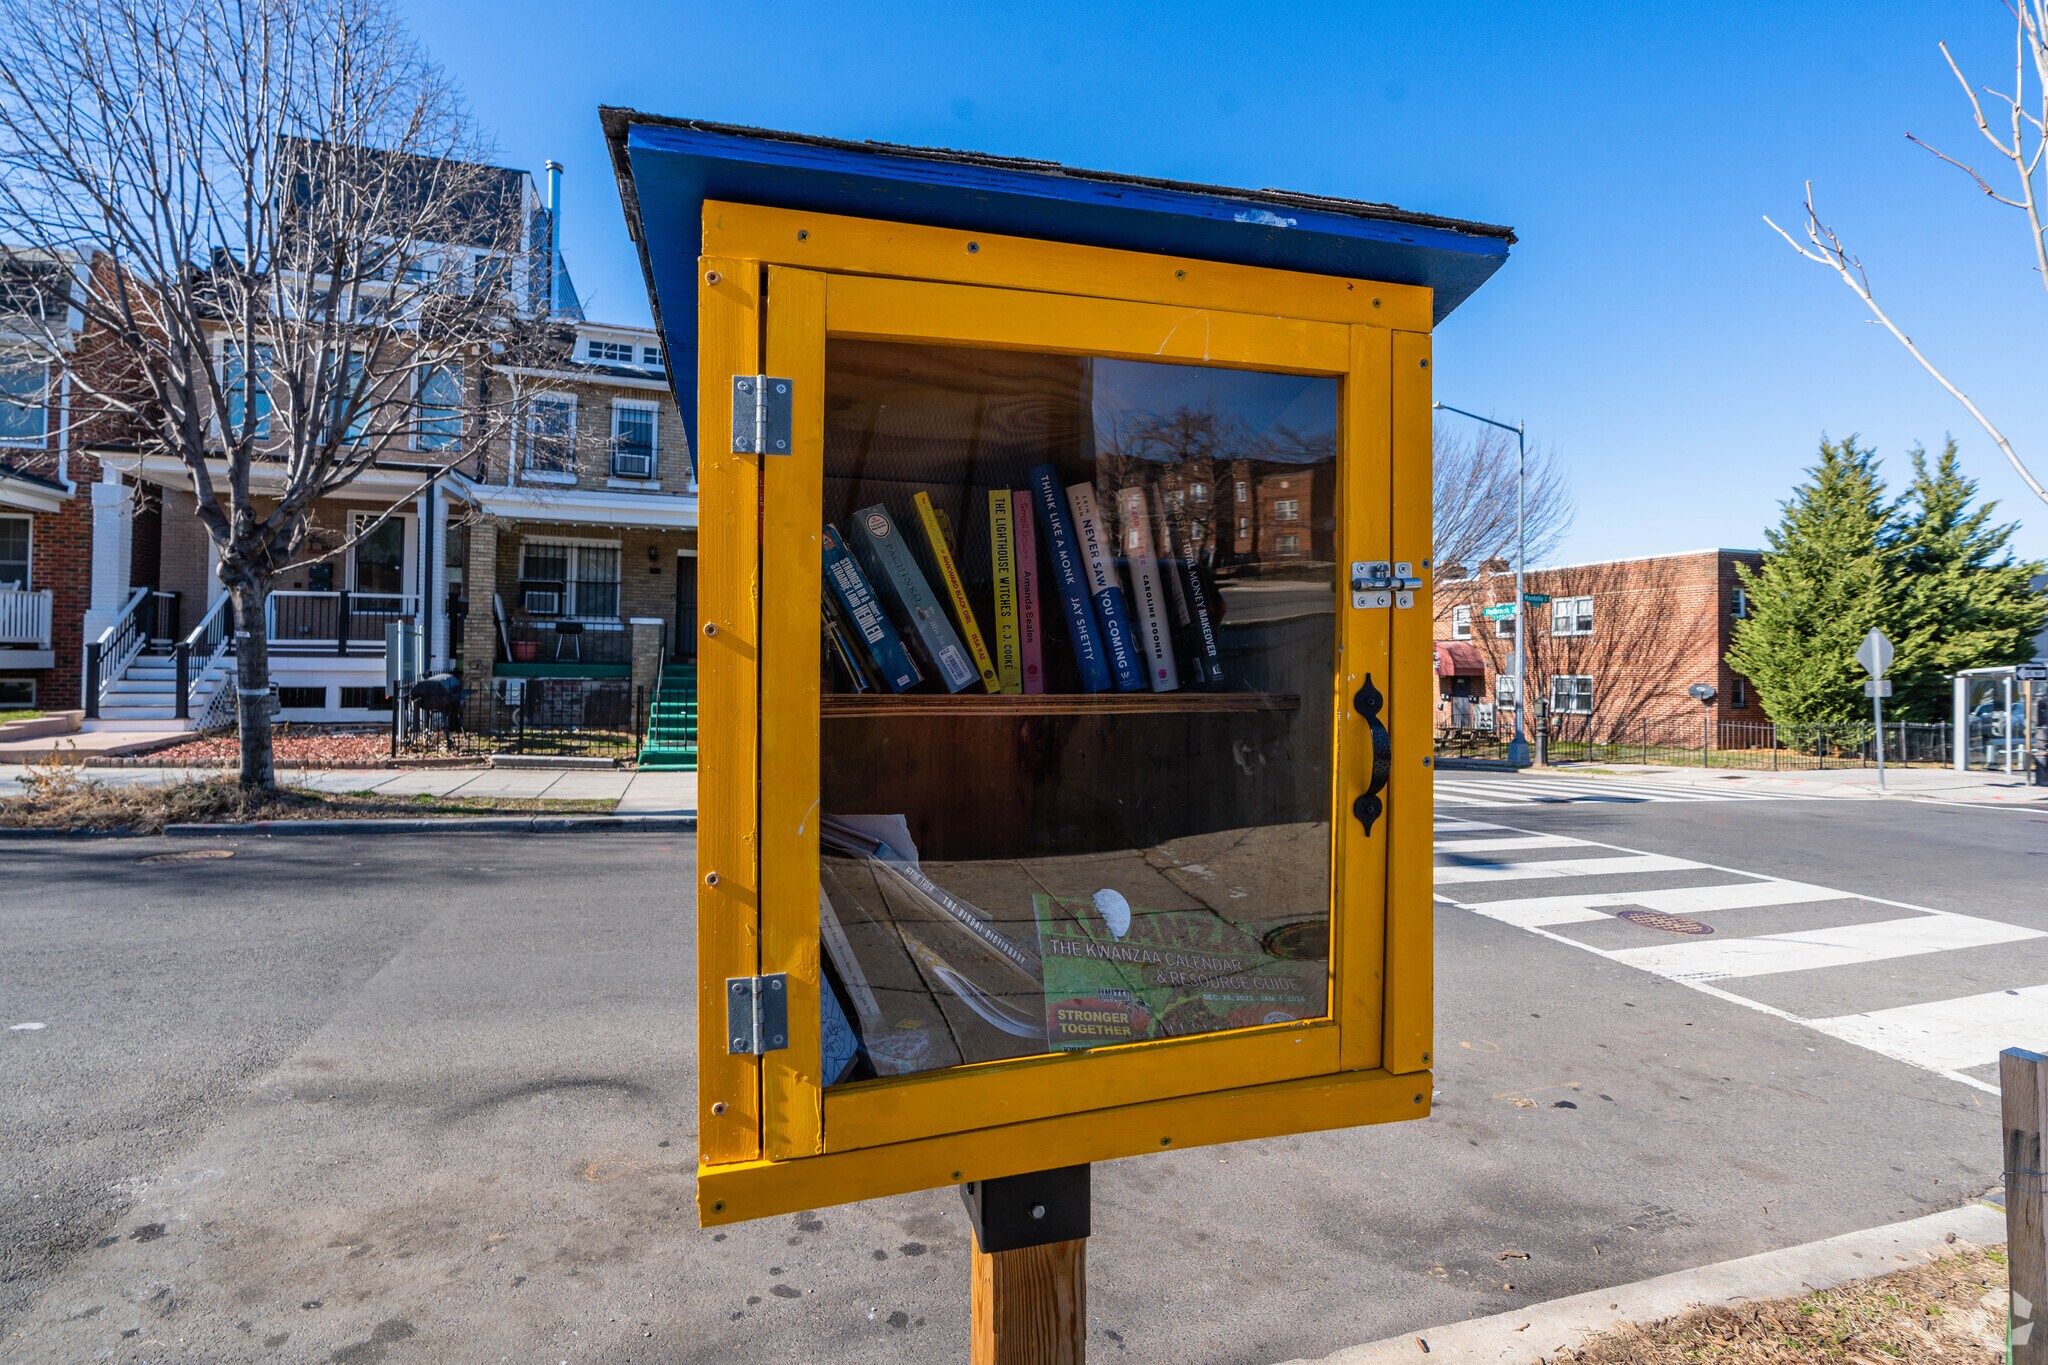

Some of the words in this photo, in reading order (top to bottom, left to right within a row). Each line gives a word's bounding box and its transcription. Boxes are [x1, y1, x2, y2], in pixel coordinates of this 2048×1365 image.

[1041, 475, 1056, 509] THINK
[1163, 464, 1176, 489] DAVE
[994, 498, 1005, 514] THE
[1020, 502, 1029, 529] Small
[1049, 513, 1062, 536] LIKE
[1083, 519, 1099, 558] NEVER
[995, 517, 1009, 573] LIGHTHOUSE
[1057, 540, 1065, 549] A
[1182, 543, 1195, 569] TOTAL
[839, 557, 863, 591] STRANGER
[885, 543, 922, 602] PACHINKO
[1059, 550, 1075, 585] MONK
[1093, 561, 1106, 587] SAW
[830, 562, 851, 591] STRANGE
[845, 589, 861, 608] LAND
[942, 555, 959, 590] AWKWARD
[954, 590, 967, 609] BLACK
[961, 610, 972, 625] GIRL
[999, 576, 1012, 617] WITCHES
[1023, 570, 1034, 609] Amanda
[1188, 570, 1205, 610] MONEY
[1070, 597, 1083, 615] JAY
[1100, 590, 1115, 616] YOU
[1142, 574, 1156, 618] CAROLINE
[1151, 622, 1163, 659] DOONER
[853, 603, 885, 644] HEINLEIN
[1002, 624, 1011, 632] C.
[1002, 634, 1011, 642] J.
[1025, 612, 1035, 643] Seales
[1198, 608, 1216, 657] MAKEOVER
[971, 633, 981, 648] ISSA
[976, 647, 986, 661] RAE
[1076, 619, 1094, 661] SHETTY
[1107, 620, 1128, 669] COMING
[1003, 644, 1013, 669] COOKE
[919, 877, 935, 894] TREK
[942, 896, 957, 912] THE
[957, 908, 985, 933] VISUAL
[984, 929, 1026, 965] DICTIONARY
[1050, 940, 1082, 957] THE
[1087, 942, 1162, 964] KWANZAA
[1166, 952, 1242, 971] CALENDAR
[1157, 970, 1166, 984] &
[1170, 972, 1249, 990] RESOURCE
[1253, 977, 1301, 991] GUIDE
[1057, 1009, 1129, 1023] STRONGER
[1059, 1022, 1131, 1035] TOGETHER
